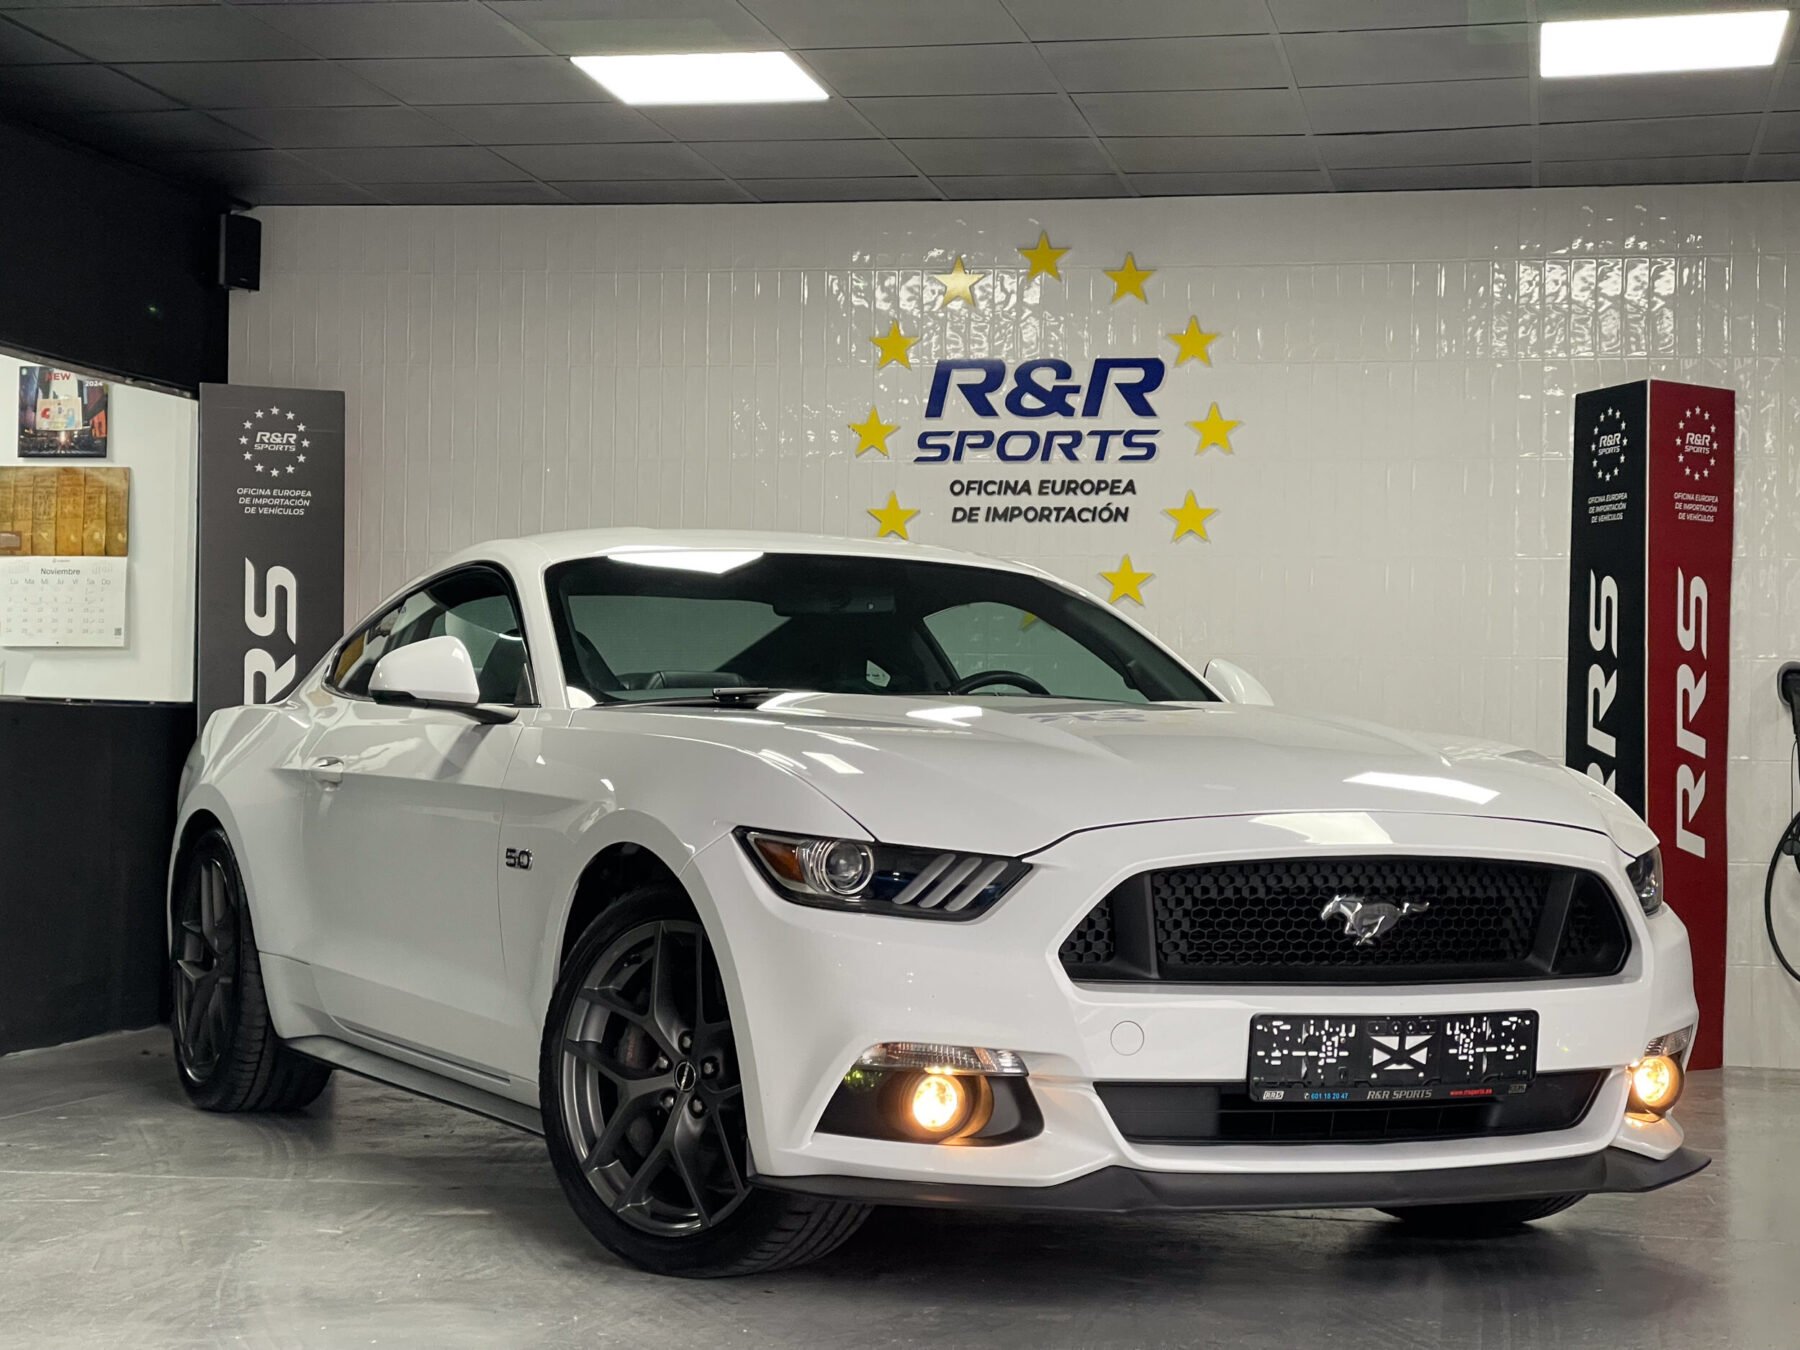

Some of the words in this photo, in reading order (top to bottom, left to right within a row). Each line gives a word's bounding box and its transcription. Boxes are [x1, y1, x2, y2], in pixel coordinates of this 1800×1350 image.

[924, 358, 1166, 418] R&R
[256, 432, 297, 444] R&R
[1599, 433, 1621, 448] R&R
[1686, 432, 1711, 447] R&R
[254, 444, 297, 452] SPORTS
[913, 430, 1161, 464] SPORTS
[1598, 446, 1621, 456] SPORTS
[1685, 445, 1711, 455] SPORTS
[237, 487, 271, 496] OFICINA
[273, 489, 312, 497] EUROPEA
[949, 479, 1032, 496] OFICINA
[1038, 478, 1137, 496] EUROPEA
[252, 497, 310, 507] IMPORTACIÓN
[1674, 492, 1695, 501] OFICINA
[1695, 494, 1719, 503] EUROPEA
[258, 506, 305, 516] VEHÍCULOS
[1675, 502, 1682, 510] DE
[951, 507, 979, 523] DE
[984, 502, 1130, 523] IMPORTACIÓN
[1678, 512, 1686, 520] DE
[40, 568, 80, 576] Noviembre
[1677, 566, 1709, 858] RRS
[1367, 1090, 1390, 1100] R&R
[1392, 1089, 1432, 1099] SPORTS
